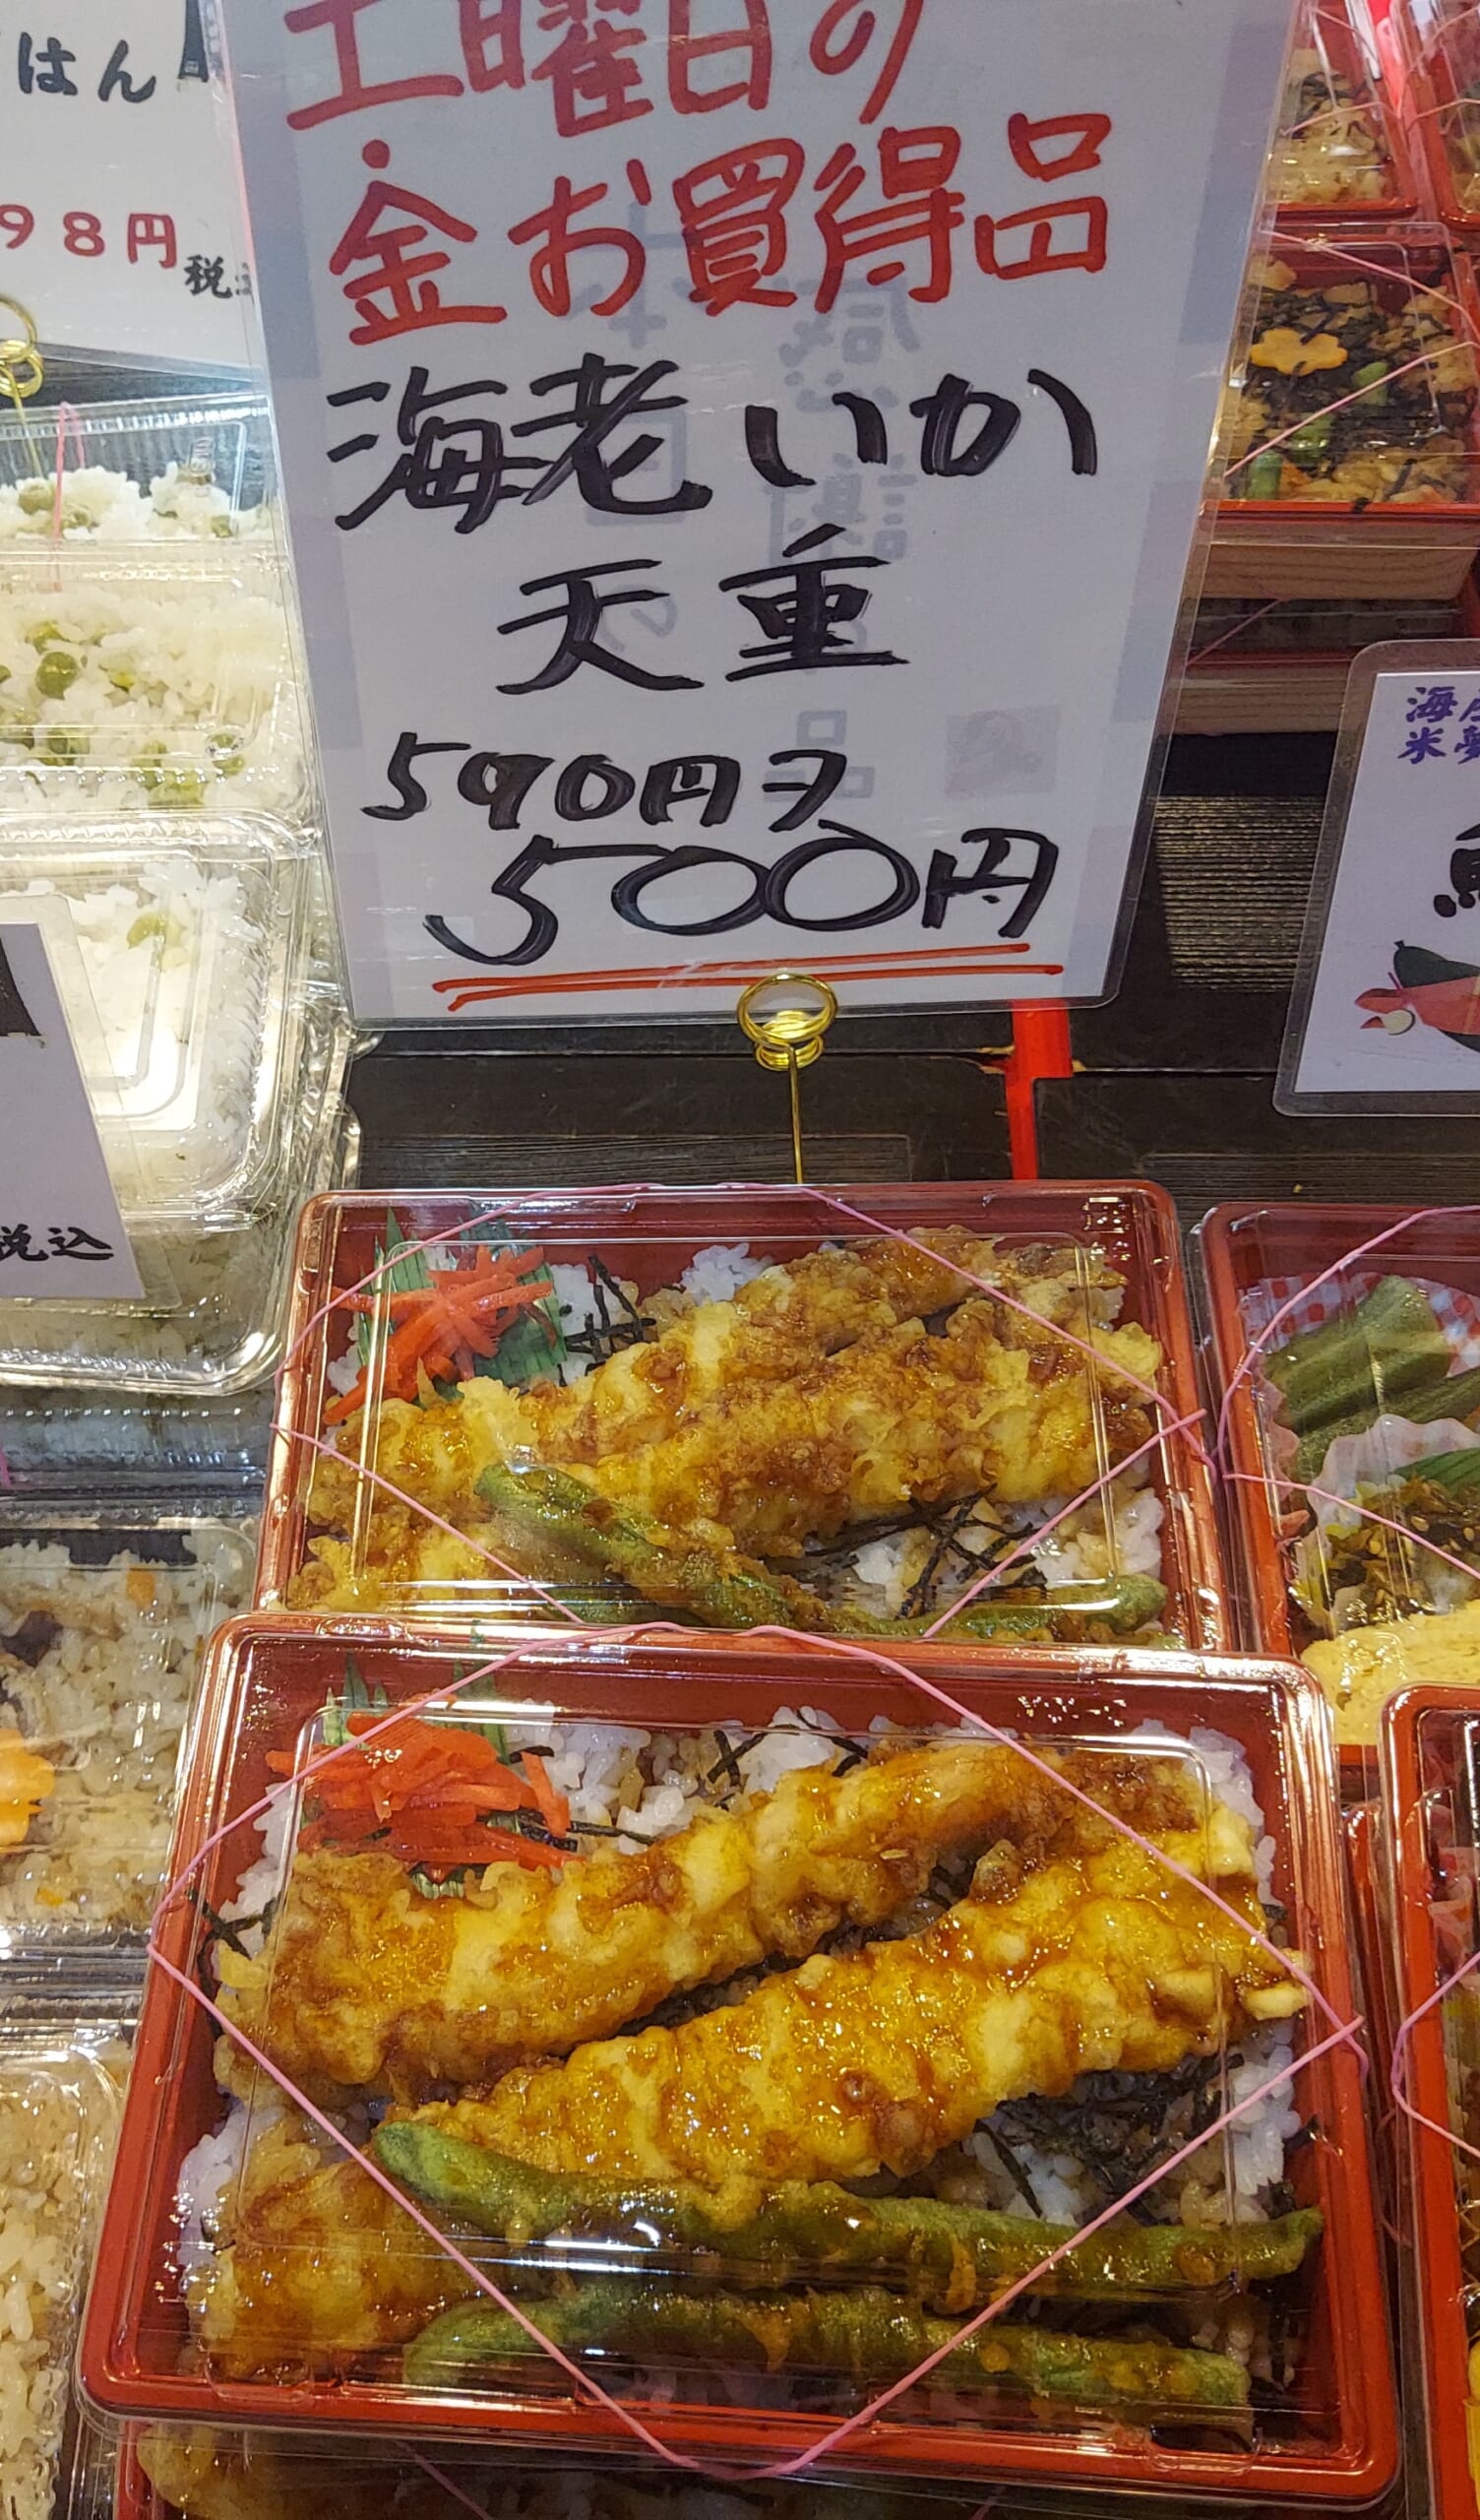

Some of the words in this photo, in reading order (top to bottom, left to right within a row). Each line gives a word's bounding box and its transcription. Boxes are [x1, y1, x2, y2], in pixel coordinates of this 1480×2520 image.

[18, 32, 156, 103] はん
[325, 349, 1099, 535] 海老いか
[495, 523, 910, 696] 天重
[423, 817, 1061, 968] 500円
